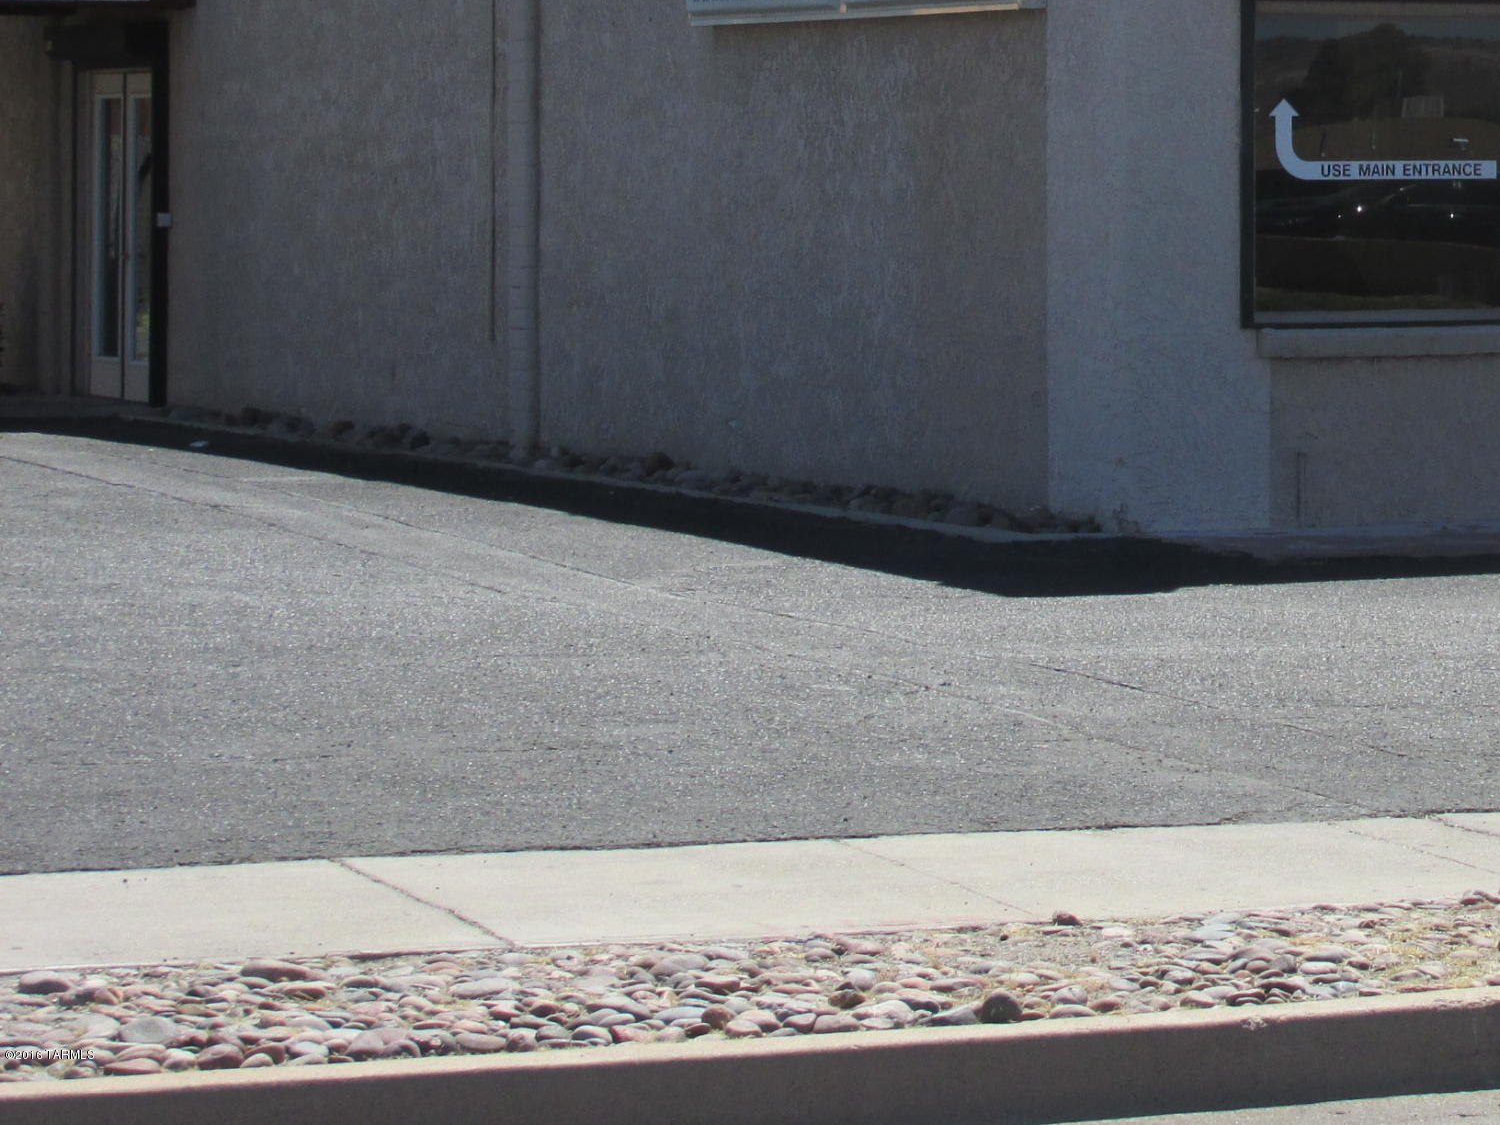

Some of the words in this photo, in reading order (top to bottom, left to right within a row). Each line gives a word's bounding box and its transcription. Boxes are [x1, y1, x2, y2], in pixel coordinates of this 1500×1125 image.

[1321, 163, 1350, 177] USE
[1358, 163, 1396, 177] MAIN
[1402, 163, 1482, 176] ENTRANCE
